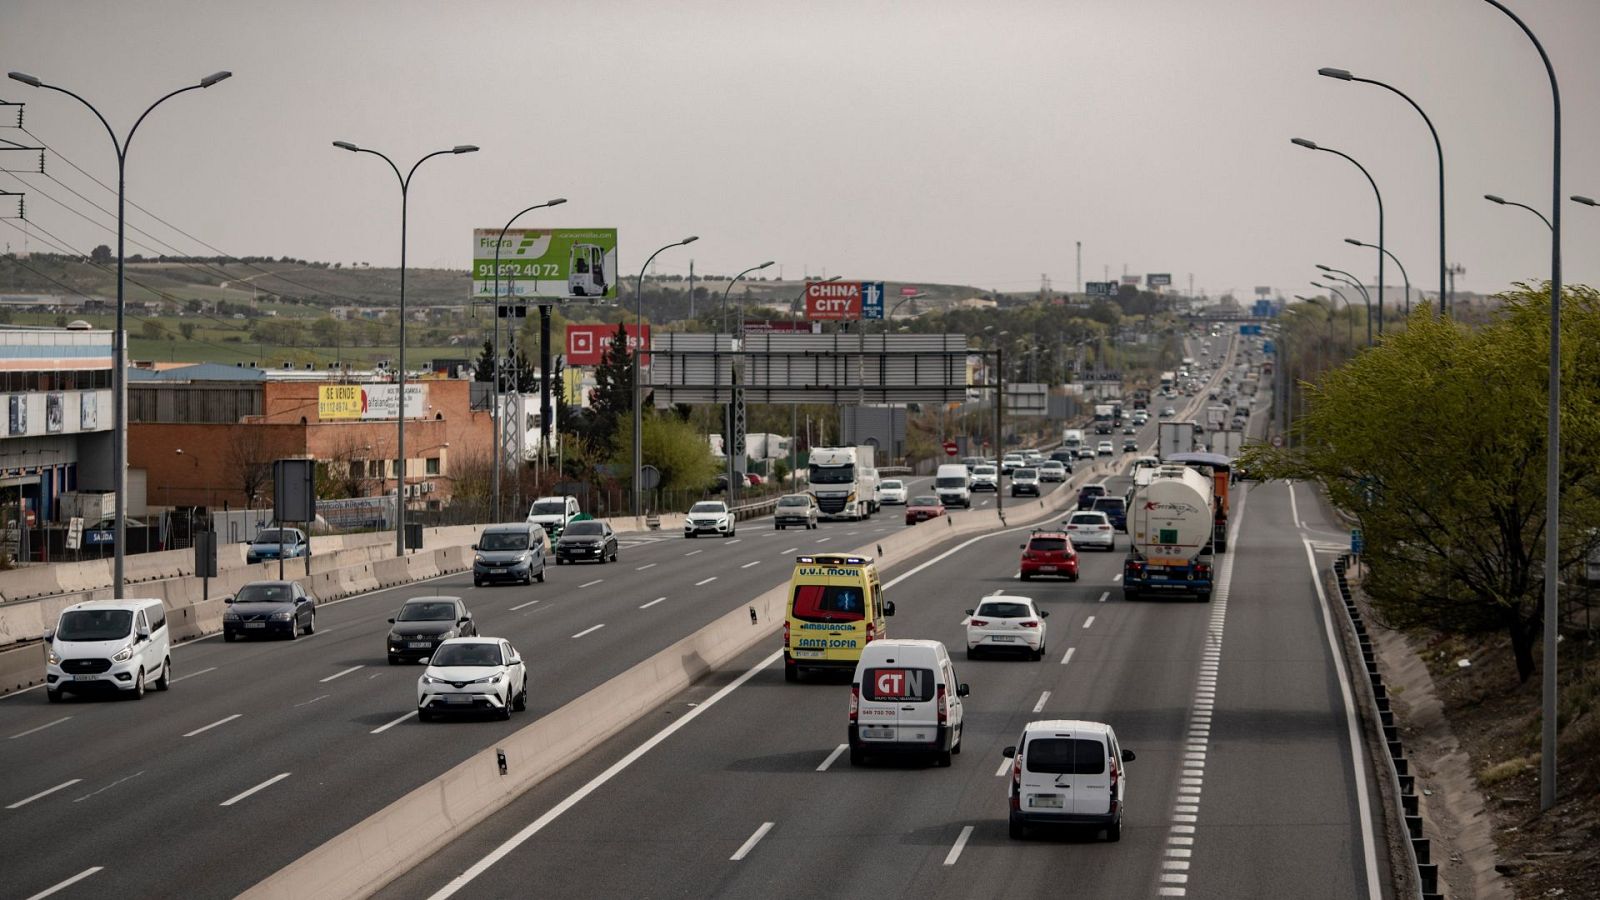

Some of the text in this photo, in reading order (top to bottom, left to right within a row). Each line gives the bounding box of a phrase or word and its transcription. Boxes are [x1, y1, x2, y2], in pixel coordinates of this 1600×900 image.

[480, 238, 513, 248] Ficara
[479, 264, 559, 276] 91 692 40 72
[809, 285, 859, 297] CHINA
[815, 299, 852, 311] CITY
[325, 387, 355, 400] SE VENDE
[827, 568, 859, 577] MOVIL
[803, 623, 853, 631] AMBULANCIA
[798, 638, 857, 648] SANTA SOFIA
[878, 670, 923, 697] GTN
